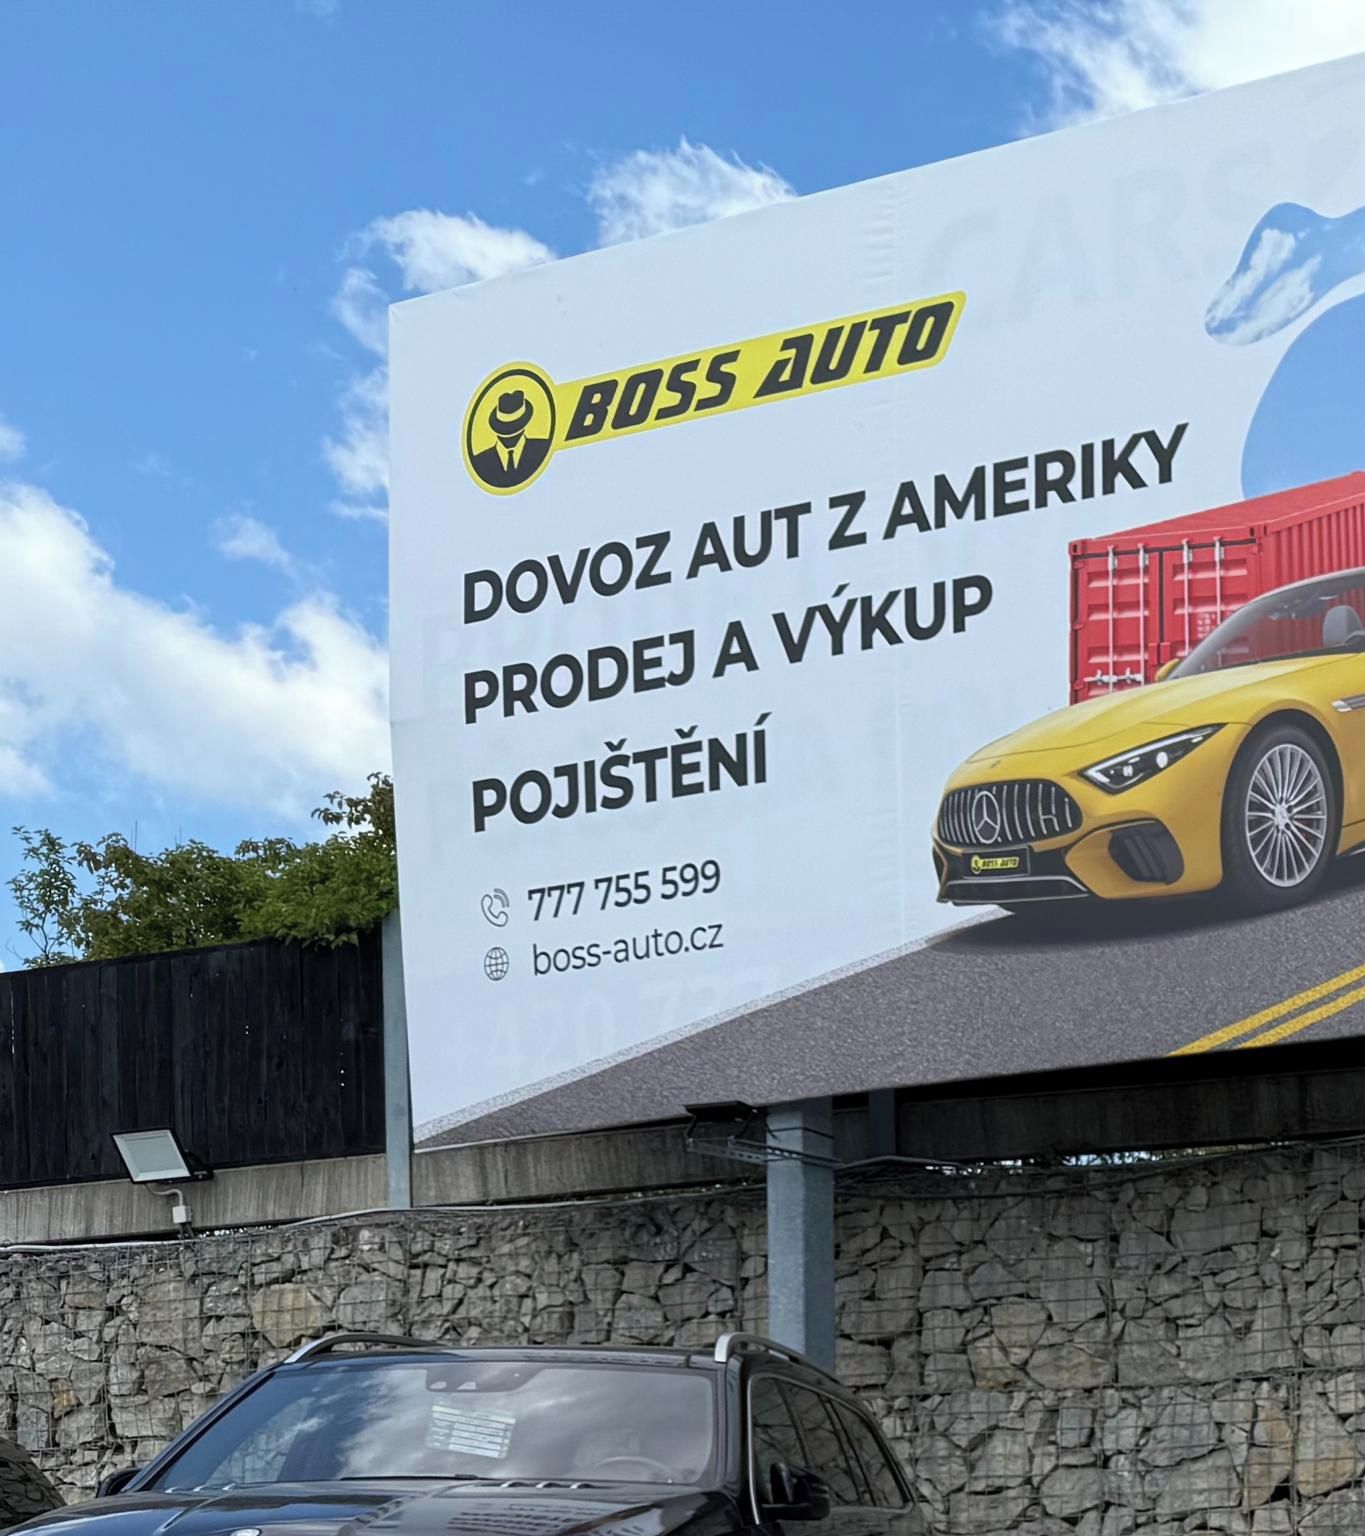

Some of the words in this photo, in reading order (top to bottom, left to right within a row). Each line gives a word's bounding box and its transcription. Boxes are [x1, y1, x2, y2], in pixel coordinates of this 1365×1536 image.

[564, 349, 742, 442] BOSS
[753, 301, 955, 399] AUTO
[463, 530, 673, 625] DOVOZ
[686, 501, 813, 580] AUT
[828, 490, 868, 551] Z
[882, 422, 1189, 541] AMERIKY
[464, 629, 696, 726] PRODEJ
[712, 620, 760, 679] A
[771, 574, 993, 665] VÝKUP
[472, 712, 772, 833] POJIŠTĚNÍ
[526, 880, 586, 922] 777
[594, 869, 653, 911] 755
[660, 859, 721, 901] 599
[532, 923, 725, 976] boss-auto.cz
